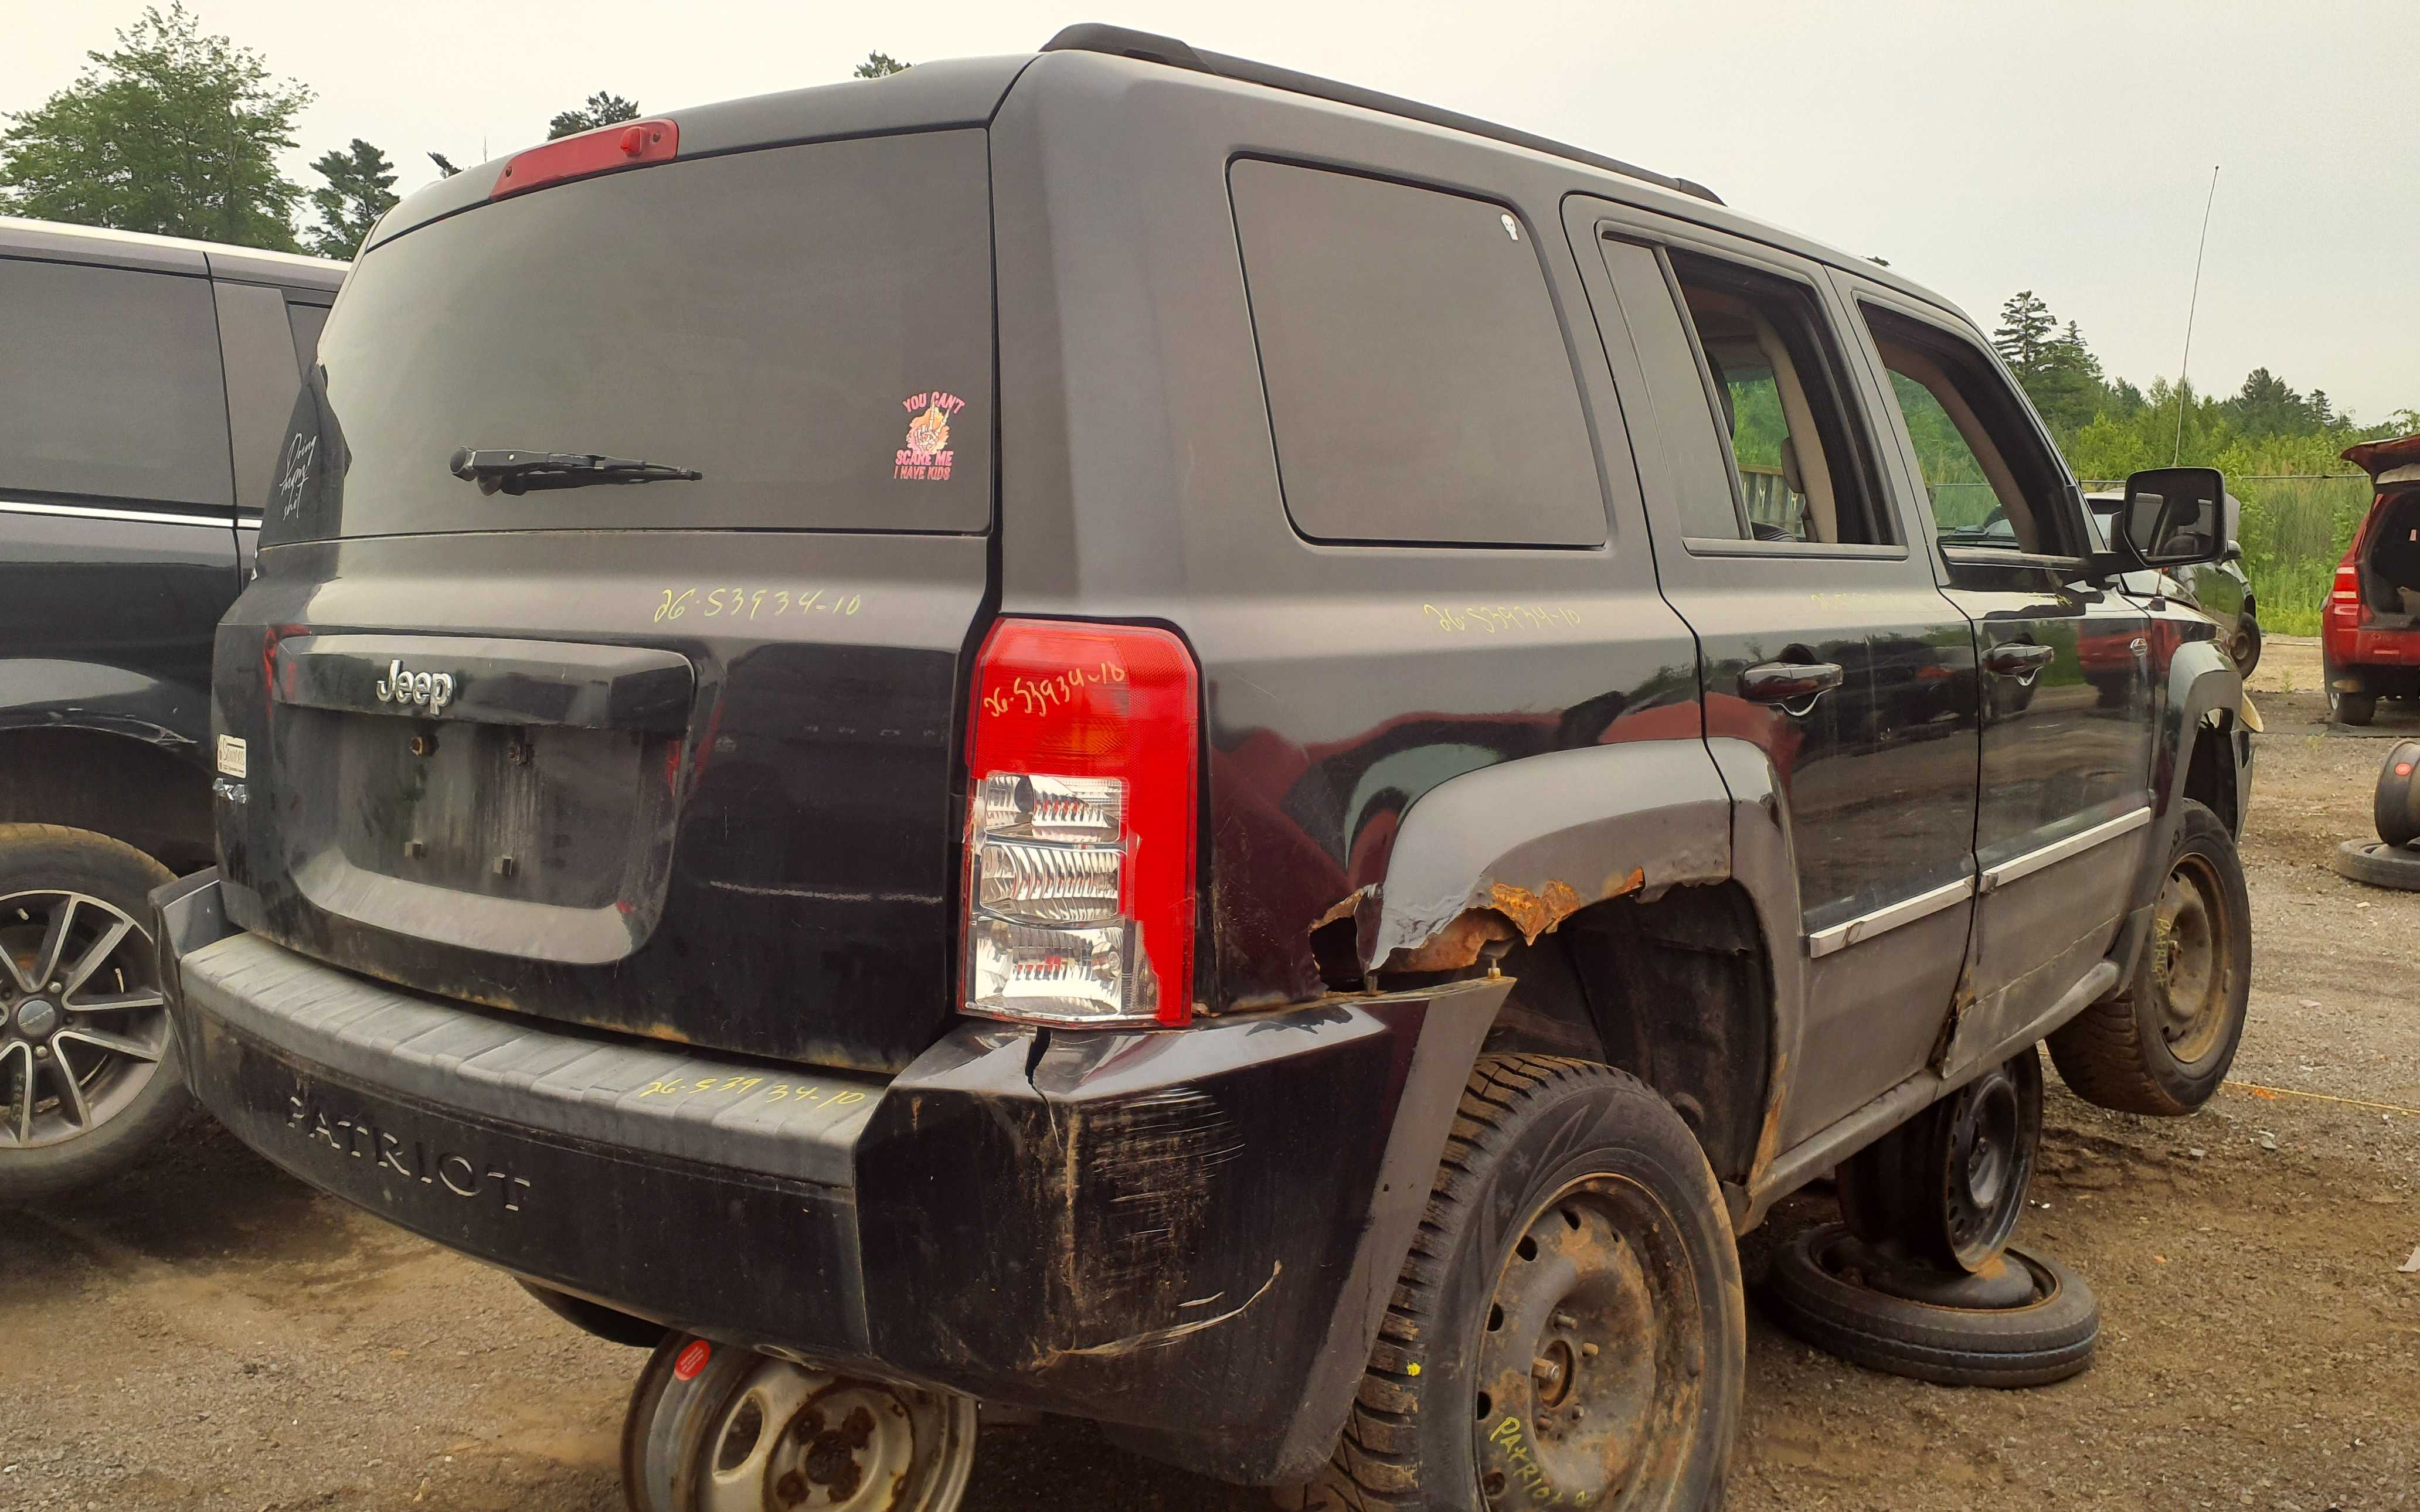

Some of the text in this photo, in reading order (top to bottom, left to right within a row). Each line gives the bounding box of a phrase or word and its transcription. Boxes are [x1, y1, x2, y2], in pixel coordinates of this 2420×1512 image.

[903, 392, 927, 413] YOU
[895, 449, 954, 466] SCARE ME
[893, 465, 951, 481] I HAVE KIDS
[376, 659, 453, 716] Jeep
[286, 1094, 531, 1212] PATRIOT
